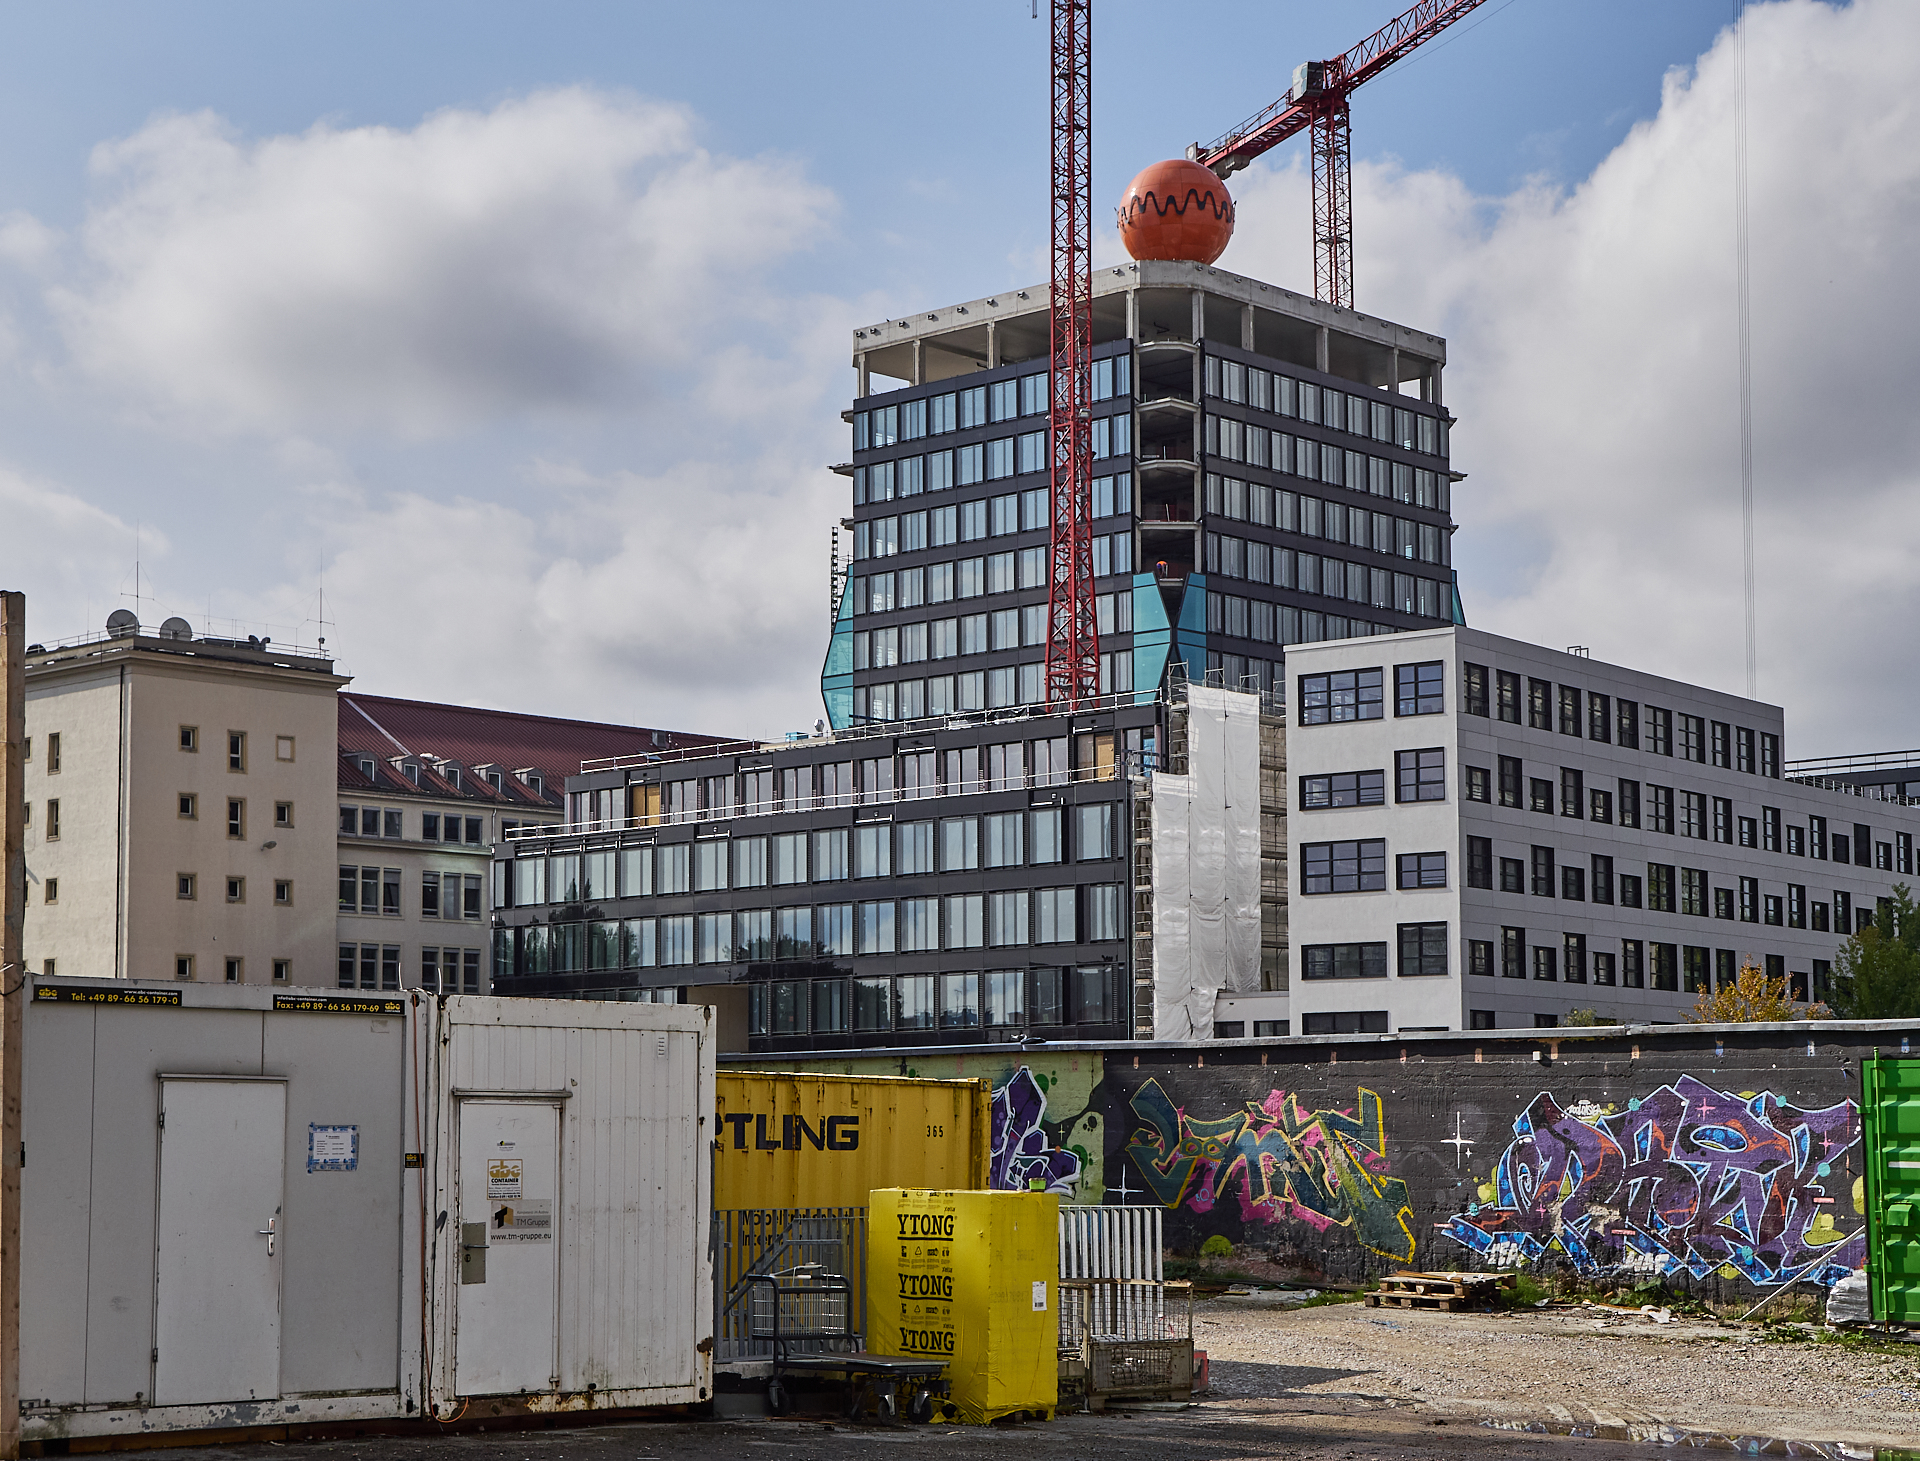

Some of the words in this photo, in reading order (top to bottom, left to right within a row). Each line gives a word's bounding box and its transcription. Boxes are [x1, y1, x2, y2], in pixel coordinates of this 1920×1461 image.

[71, 993, 86, 1001] Tel:
[89, 994, 105, 1002] +49
[277, 1001, 294, 1009] Fax:
[341, 1003, 351, 1011] 56
[926, 1125, 944, 1138] 365
[490, 1160, 520, 1178] abc
[897, 1214, 954, 1236] YTONG
[490, 1233, 551, 1241] www.tm-gruppe.eu
[898, 1273, 953, 1297] YTONG
[899, 1327, 954, 1351] YTONG
